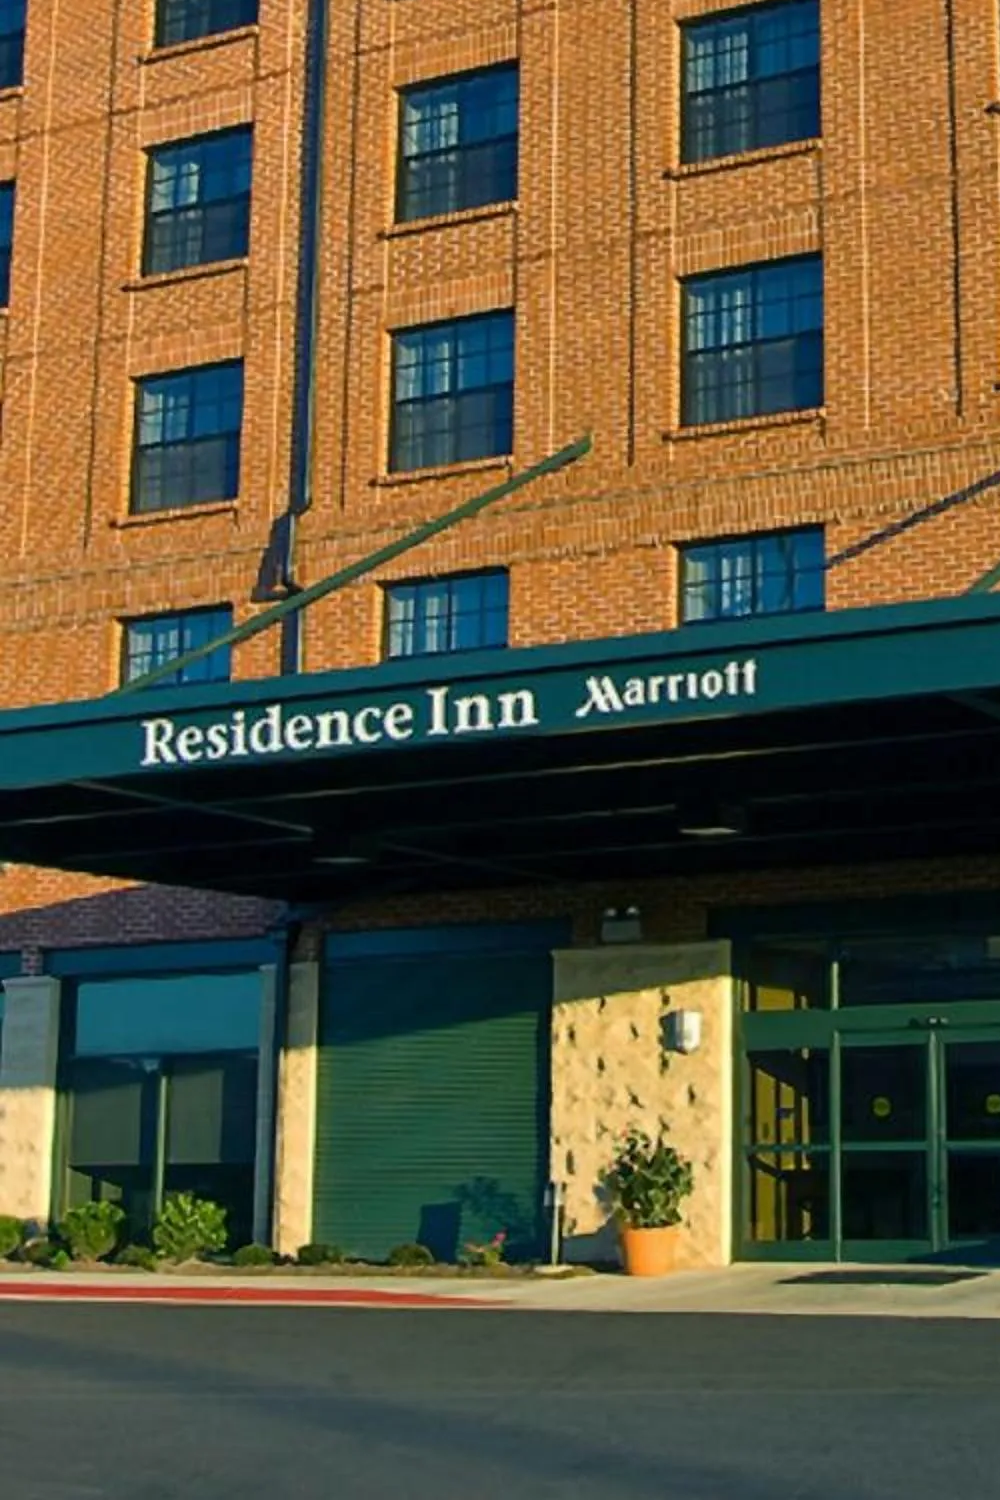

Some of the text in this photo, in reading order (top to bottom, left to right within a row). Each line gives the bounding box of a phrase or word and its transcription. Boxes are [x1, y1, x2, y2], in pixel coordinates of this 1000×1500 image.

[141, 659, 757, 766] Residence Inn Marriott
